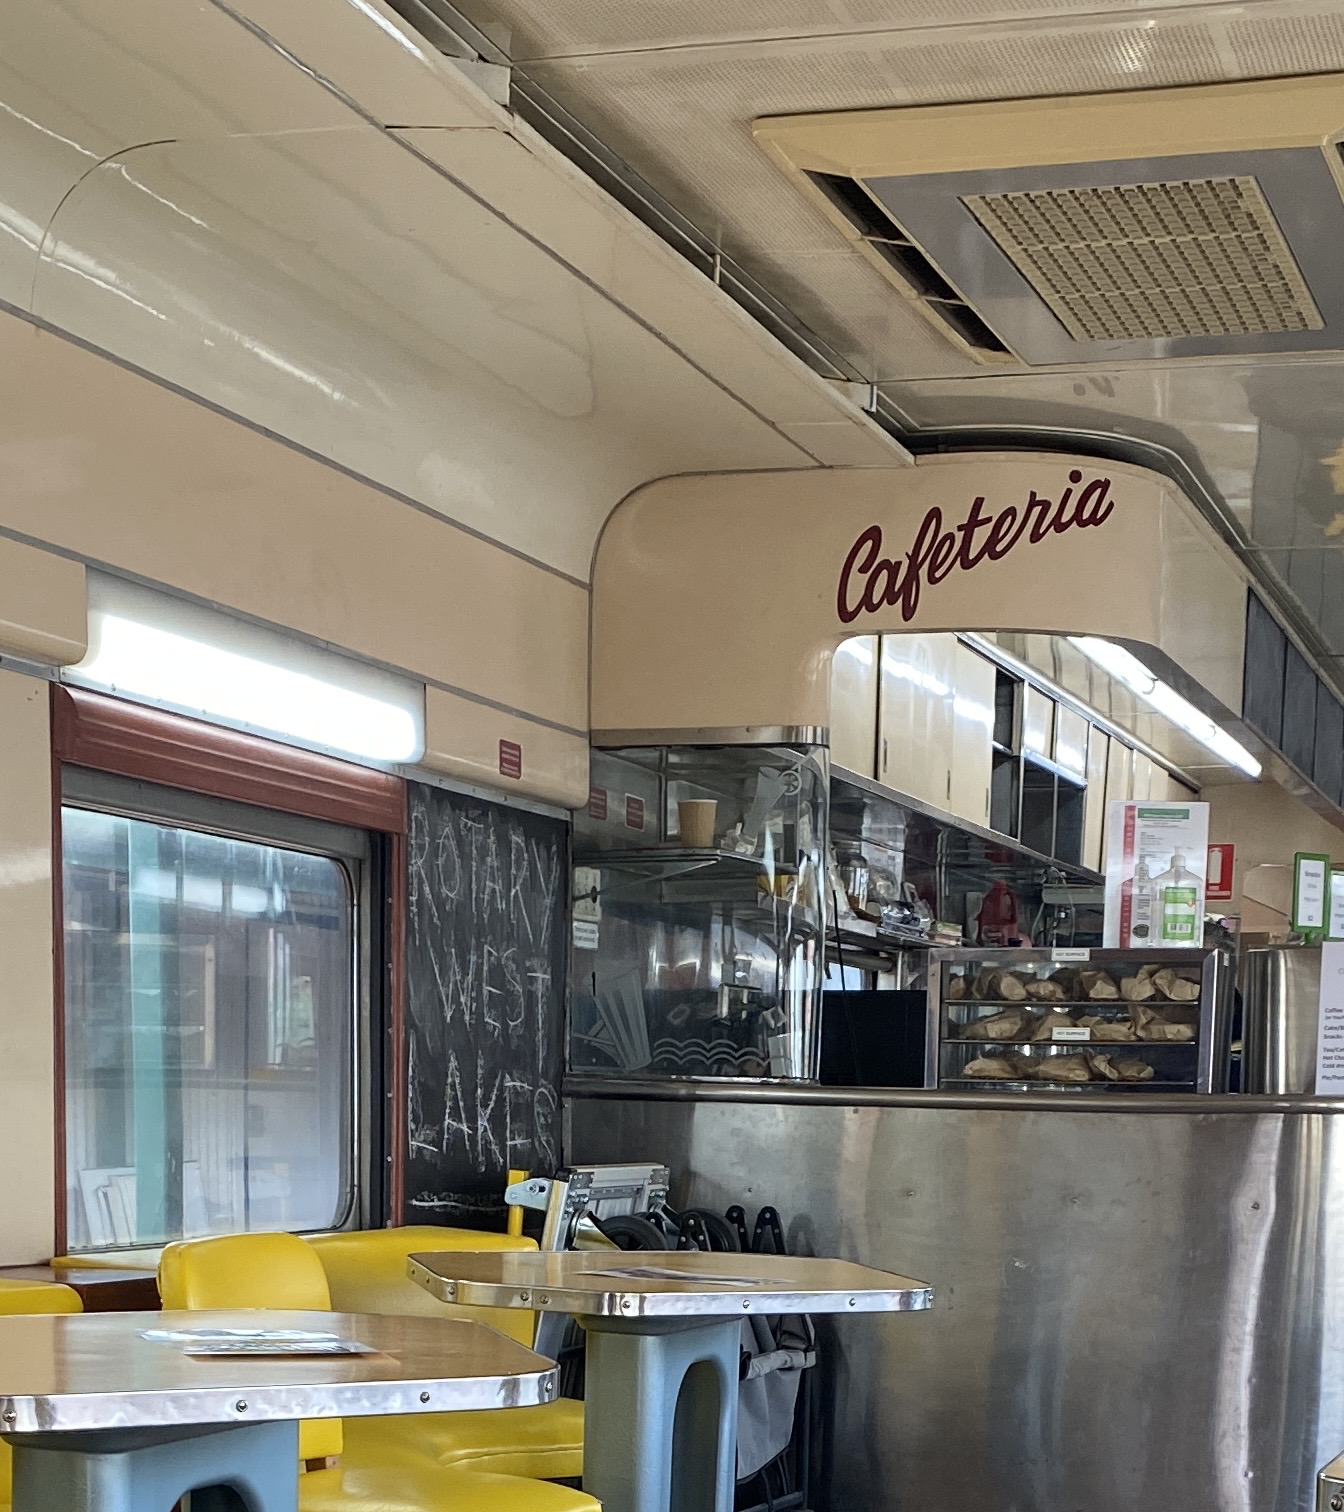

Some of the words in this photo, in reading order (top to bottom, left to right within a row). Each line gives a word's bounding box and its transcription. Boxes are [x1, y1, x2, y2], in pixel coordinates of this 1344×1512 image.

[837, 469, 1115, 624] Cafeteria
[408, 806, 561, 945] ROTARY
[426, 940, 552, 1074] WEST
[407, 1030, 559, 1178] LAKES
